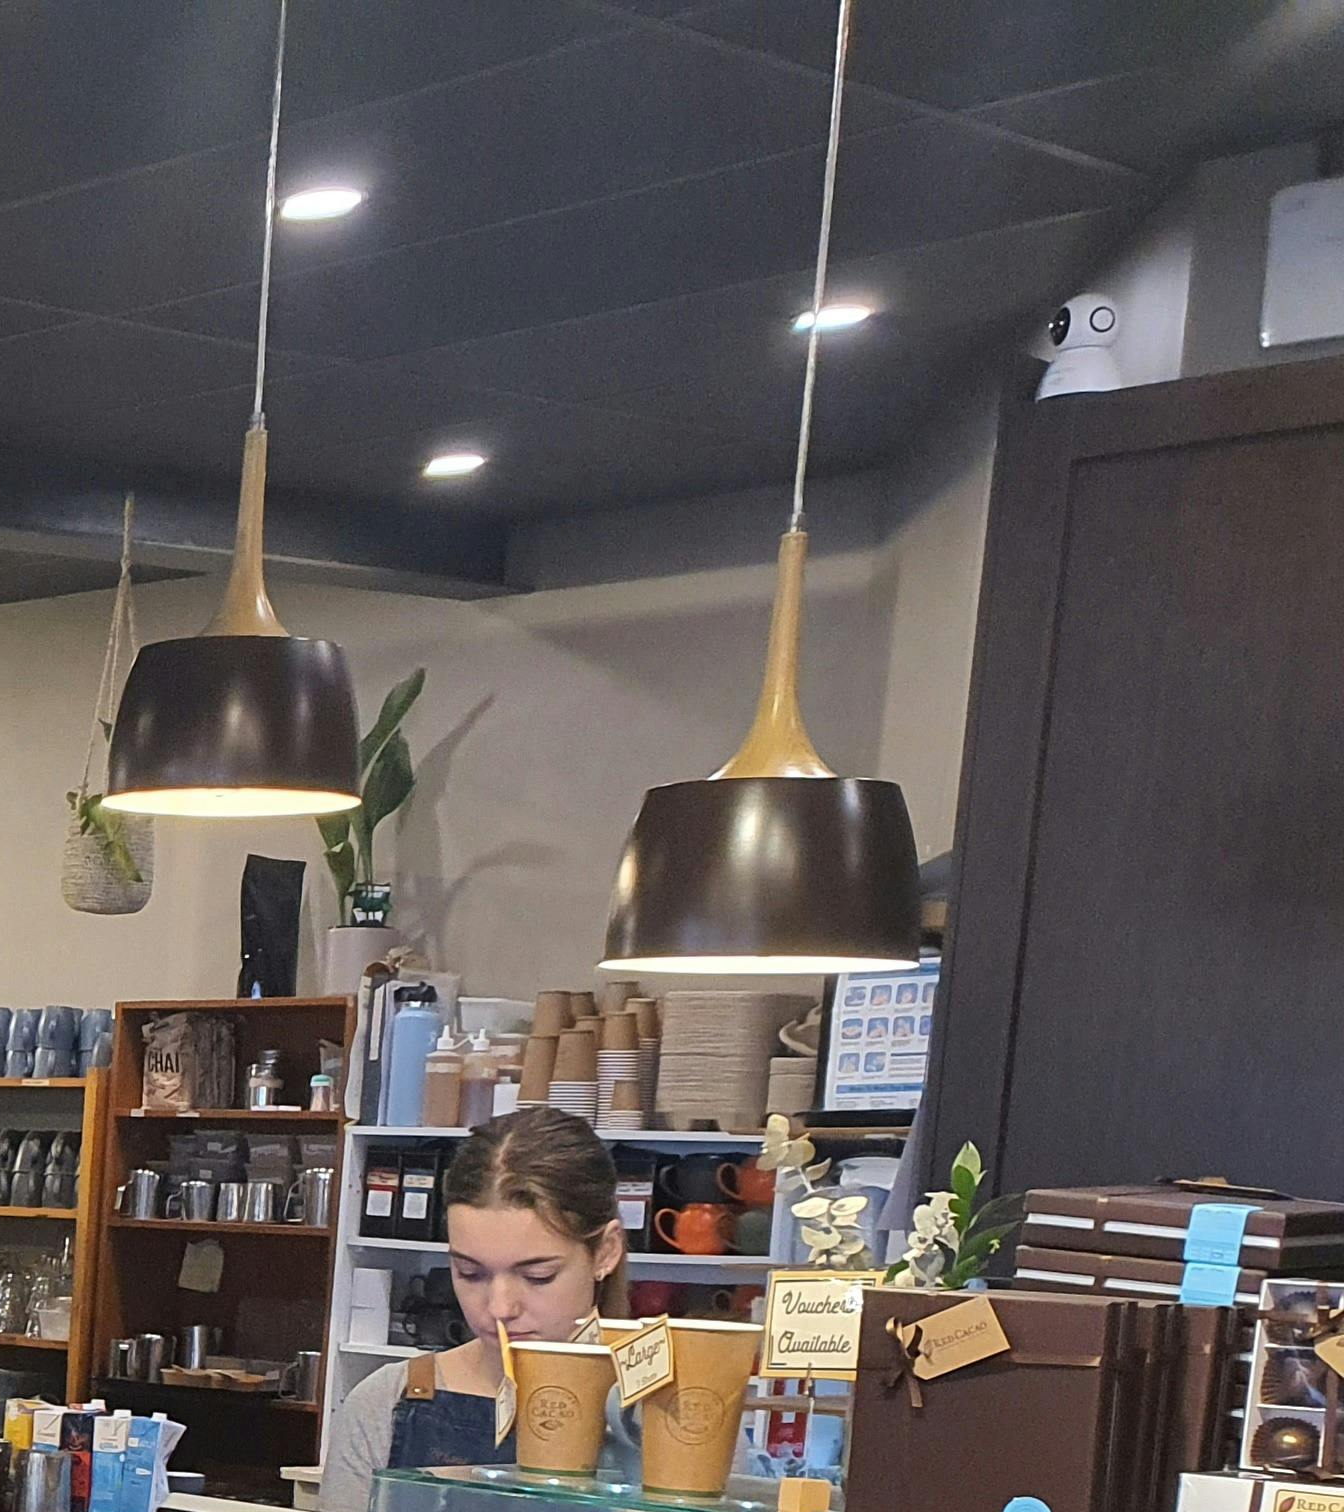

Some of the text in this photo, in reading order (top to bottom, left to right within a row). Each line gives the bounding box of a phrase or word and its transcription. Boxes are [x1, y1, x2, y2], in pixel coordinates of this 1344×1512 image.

[147, 1050, 180, 1073] CHAI
[955, 1322, 988, 1340] CACAO
[778, 1330, 852, 1354] Available
[625, 1342, 661, 1371] Large
[541, 1399, 567, 1409] RED
[532, 1407, 575, 1420] CACAO
[1296, 1498, 1327, 1512] RED
